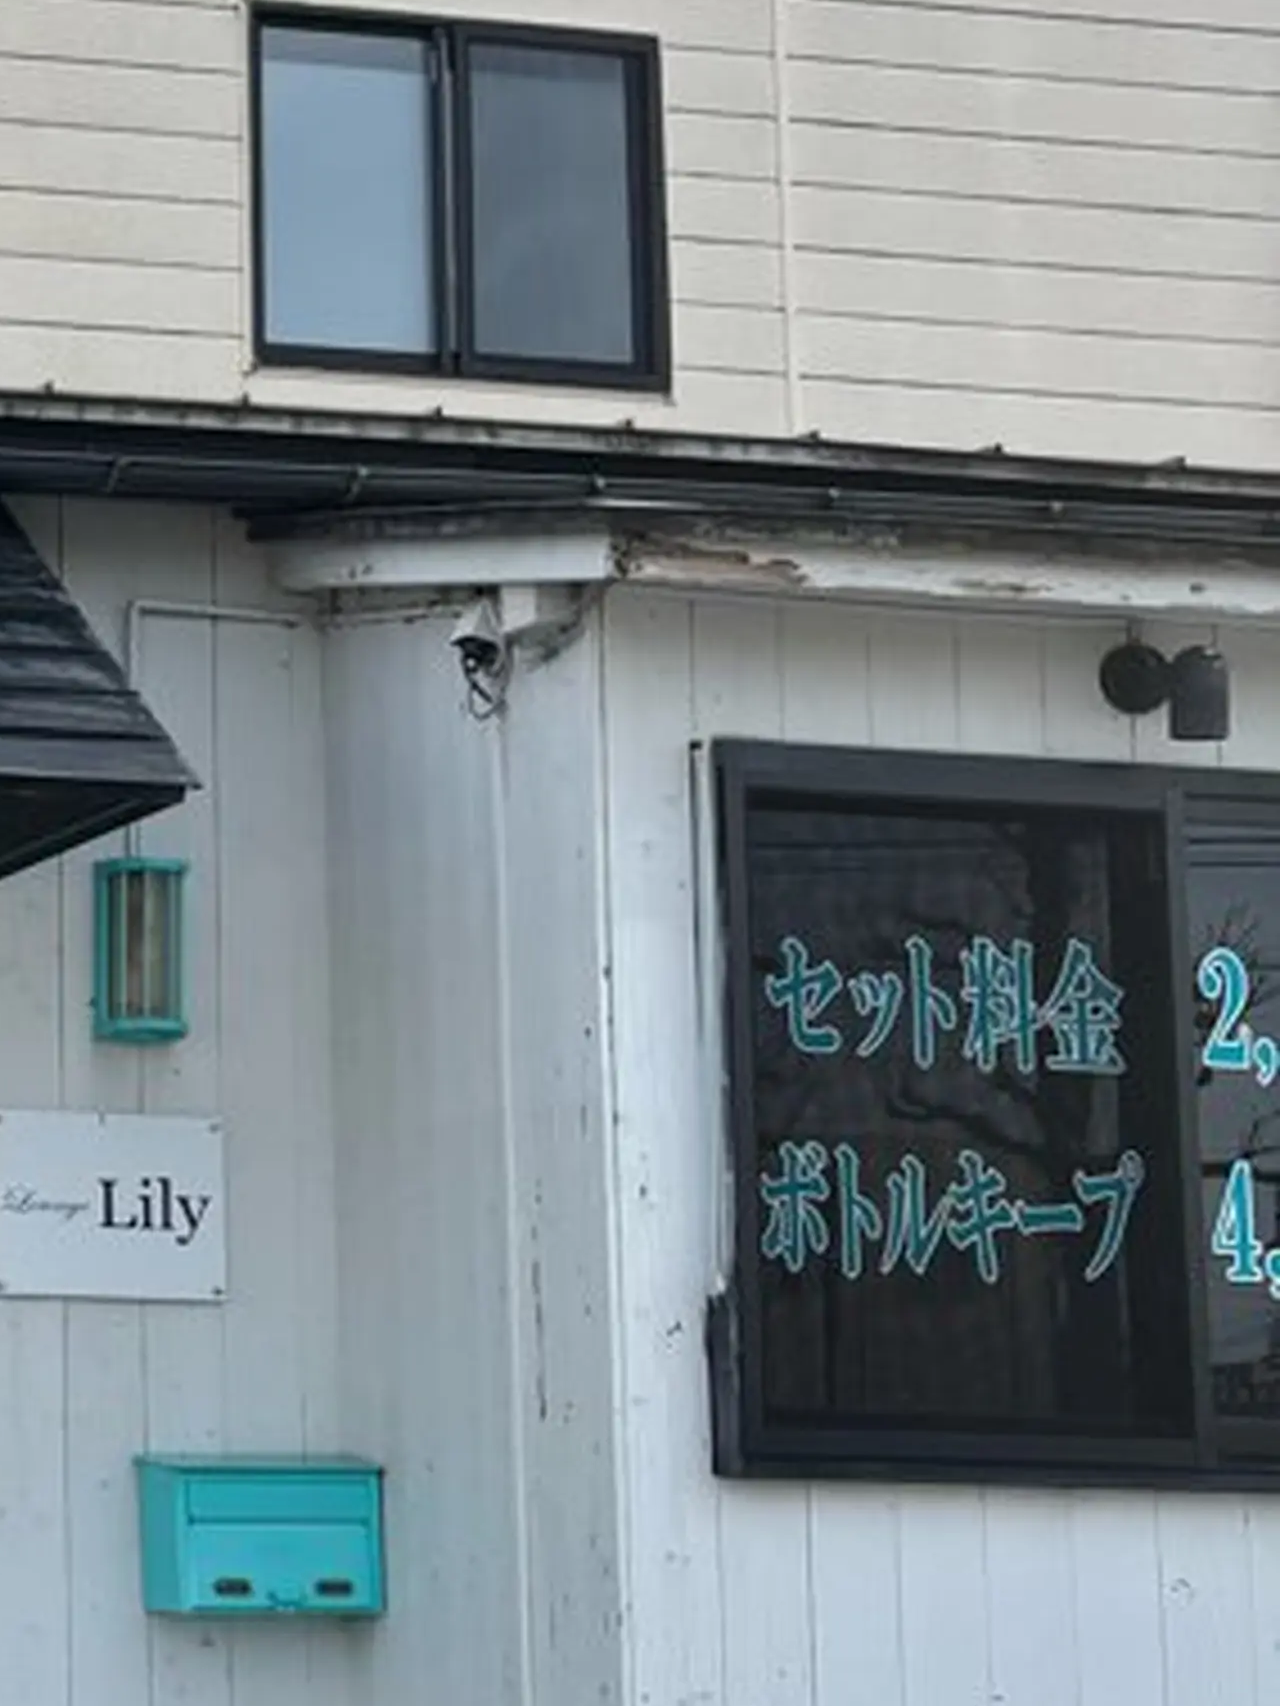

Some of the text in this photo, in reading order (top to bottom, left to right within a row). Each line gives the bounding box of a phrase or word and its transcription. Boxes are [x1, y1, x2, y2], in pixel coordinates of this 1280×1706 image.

[766, 934, 1127, 1076] セット料金
[98, 1176, 212, 1246] Lily
[760, 1140, 1146, 1283] ボトルキープ
